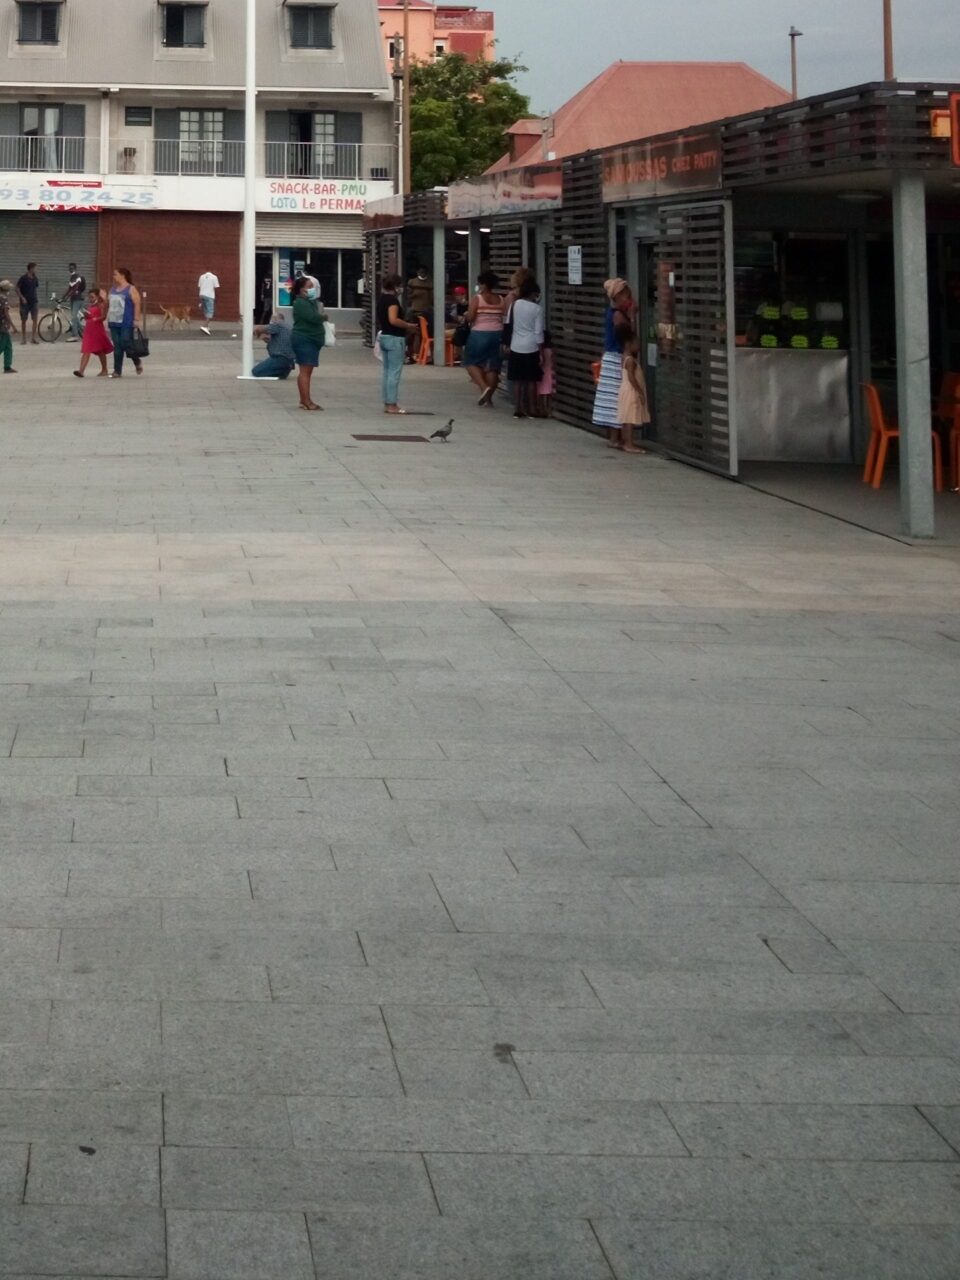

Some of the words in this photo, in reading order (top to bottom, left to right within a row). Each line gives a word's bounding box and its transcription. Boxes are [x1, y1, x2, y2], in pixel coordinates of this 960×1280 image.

[671, 155, 690, 172] CHEZ
[270, 182, 367, 195] SNACK-BAR-PMU
[39, 188, 73, 202] 80
[80, 189, 114, 204] 24
[121, 191, 155, 206] 25
[270, 197, 297, 209] LOTO
[302, 198, 316, 210] Le
[320, 199, 366, 210] PERMA
